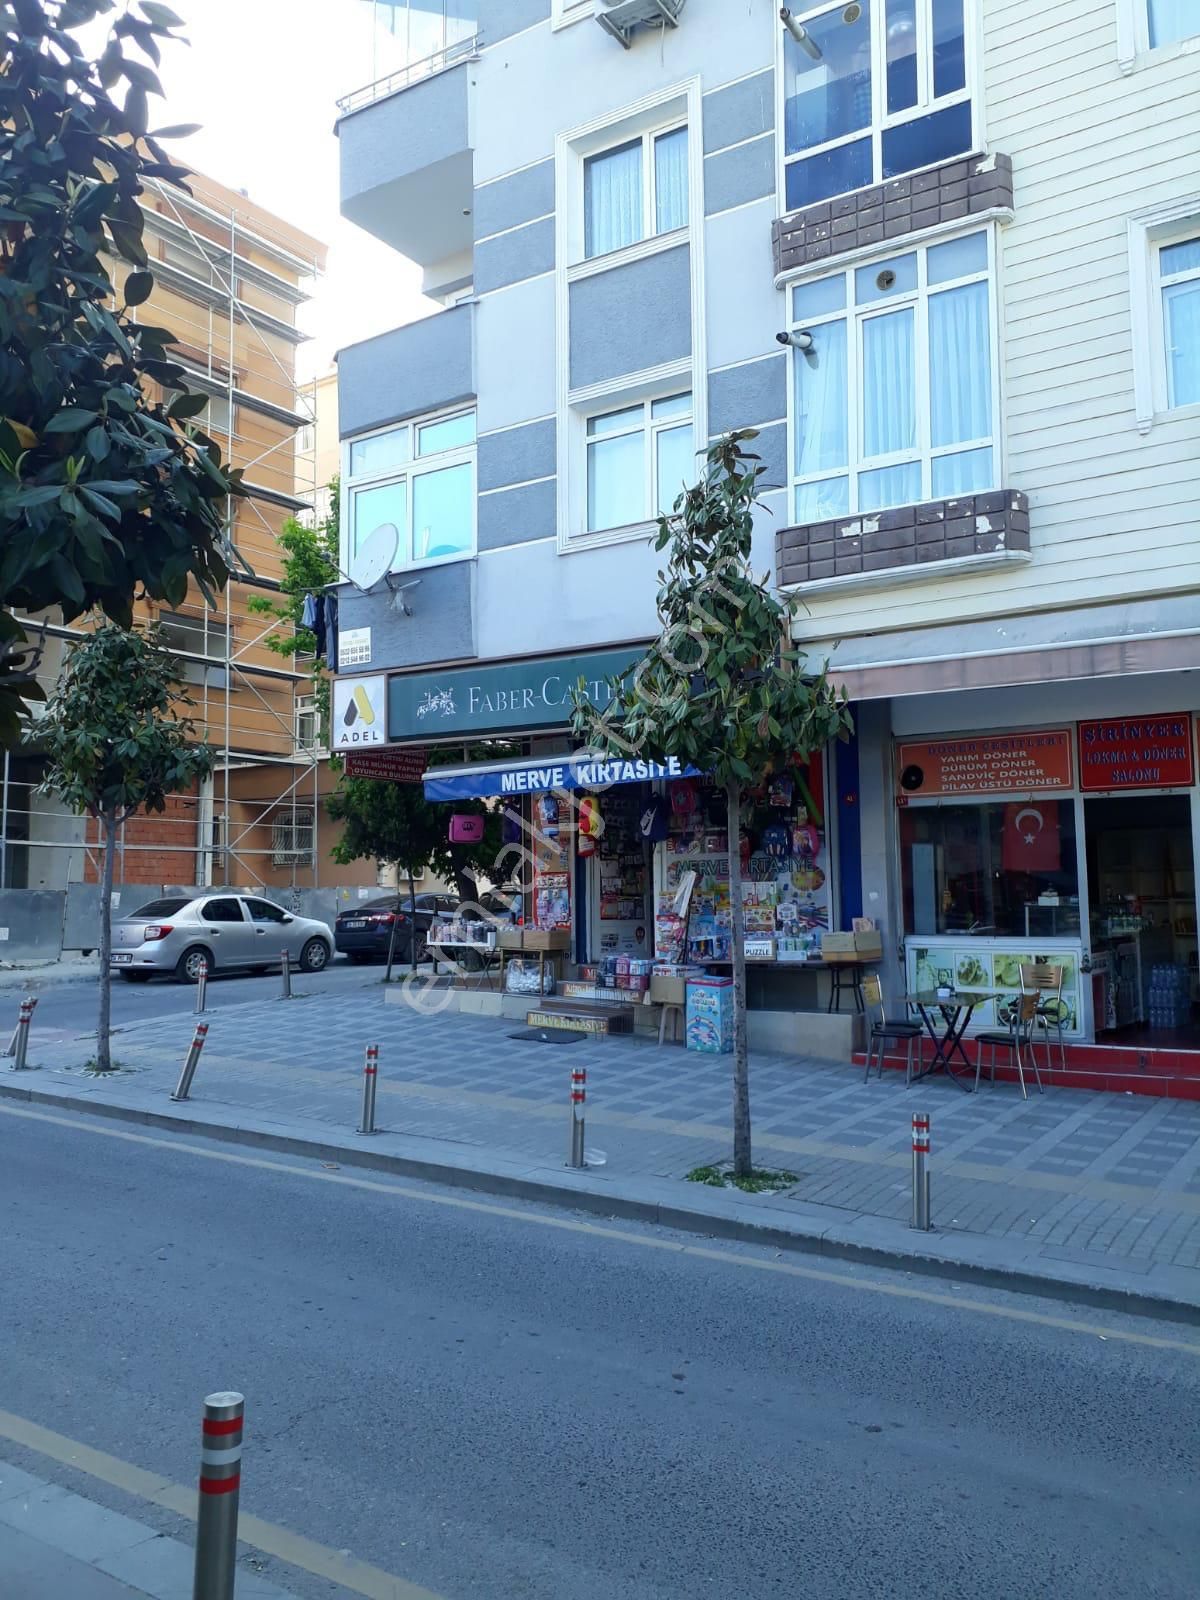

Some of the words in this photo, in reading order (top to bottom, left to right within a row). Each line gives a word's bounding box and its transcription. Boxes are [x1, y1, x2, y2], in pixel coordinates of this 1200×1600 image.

[341, 731, 378, 744] ADEL
[940, 751, 979, 763] YARIM
[984, 749, 1027, 759] DÖNER
[941, 762, 988, 773] DÜRÜM
[992, 758, 1036, 770] DÖNER
[501, 767, 564, 792] MERVE
[941, 771, 996, 782] SANDVİÇ
[1000, 767, 1044, 778] DÖNER
[1111, 767, 1160, 783] SALONU
[941, 779, 976, 791] PİLAV
[979, 777, 1011, 789] ÜSTÜ
[1015, 775, 1061, 786] DÖNER
[677, 859, 729, 876] MERVE
[745, 948, 770, 956] PUZZLE
